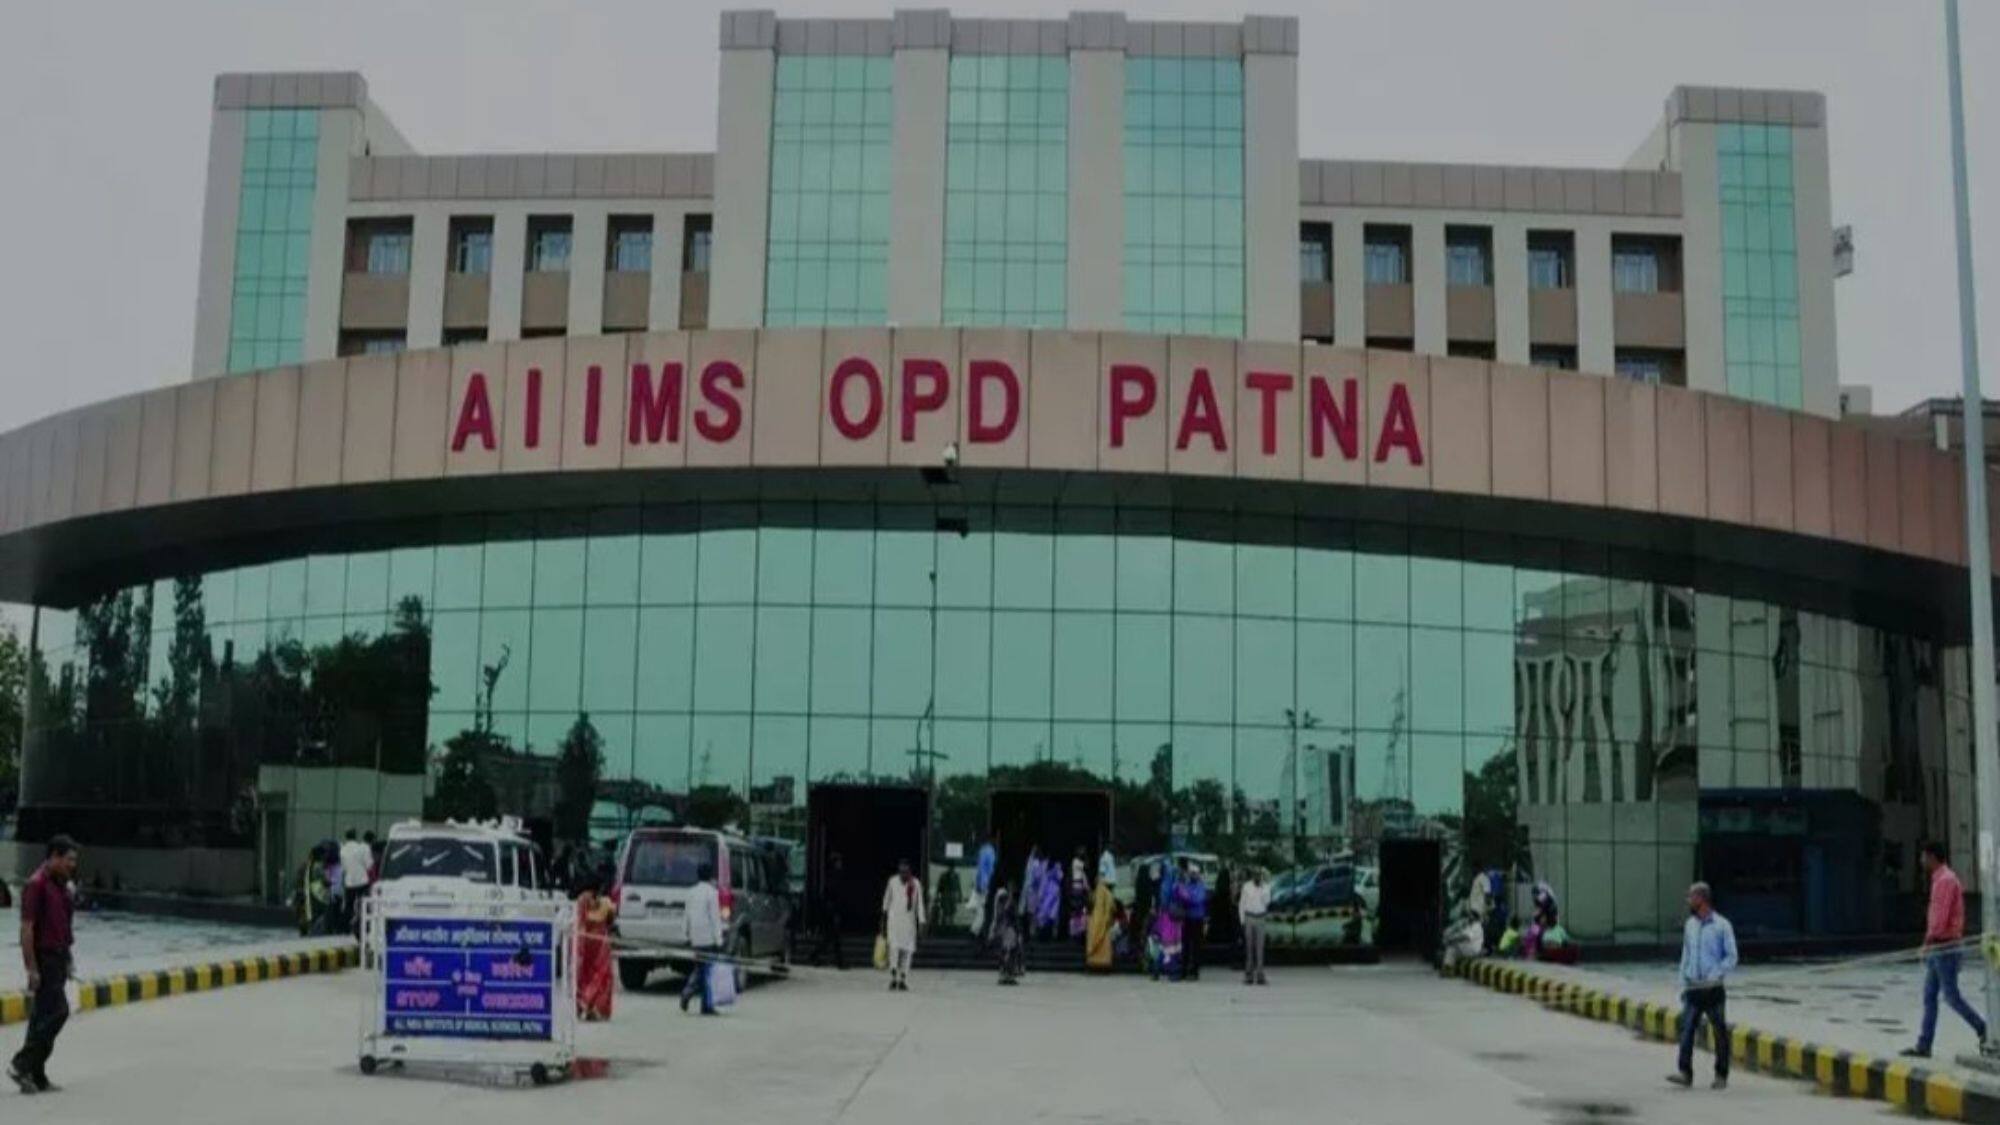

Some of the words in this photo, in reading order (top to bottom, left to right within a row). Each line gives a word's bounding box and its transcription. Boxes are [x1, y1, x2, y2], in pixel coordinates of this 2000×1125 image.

[452, 361, 745, 452] AIIMS
[829, 357, 1020, 444] OPD
[1109, 364, 1424, 466] PATNA
